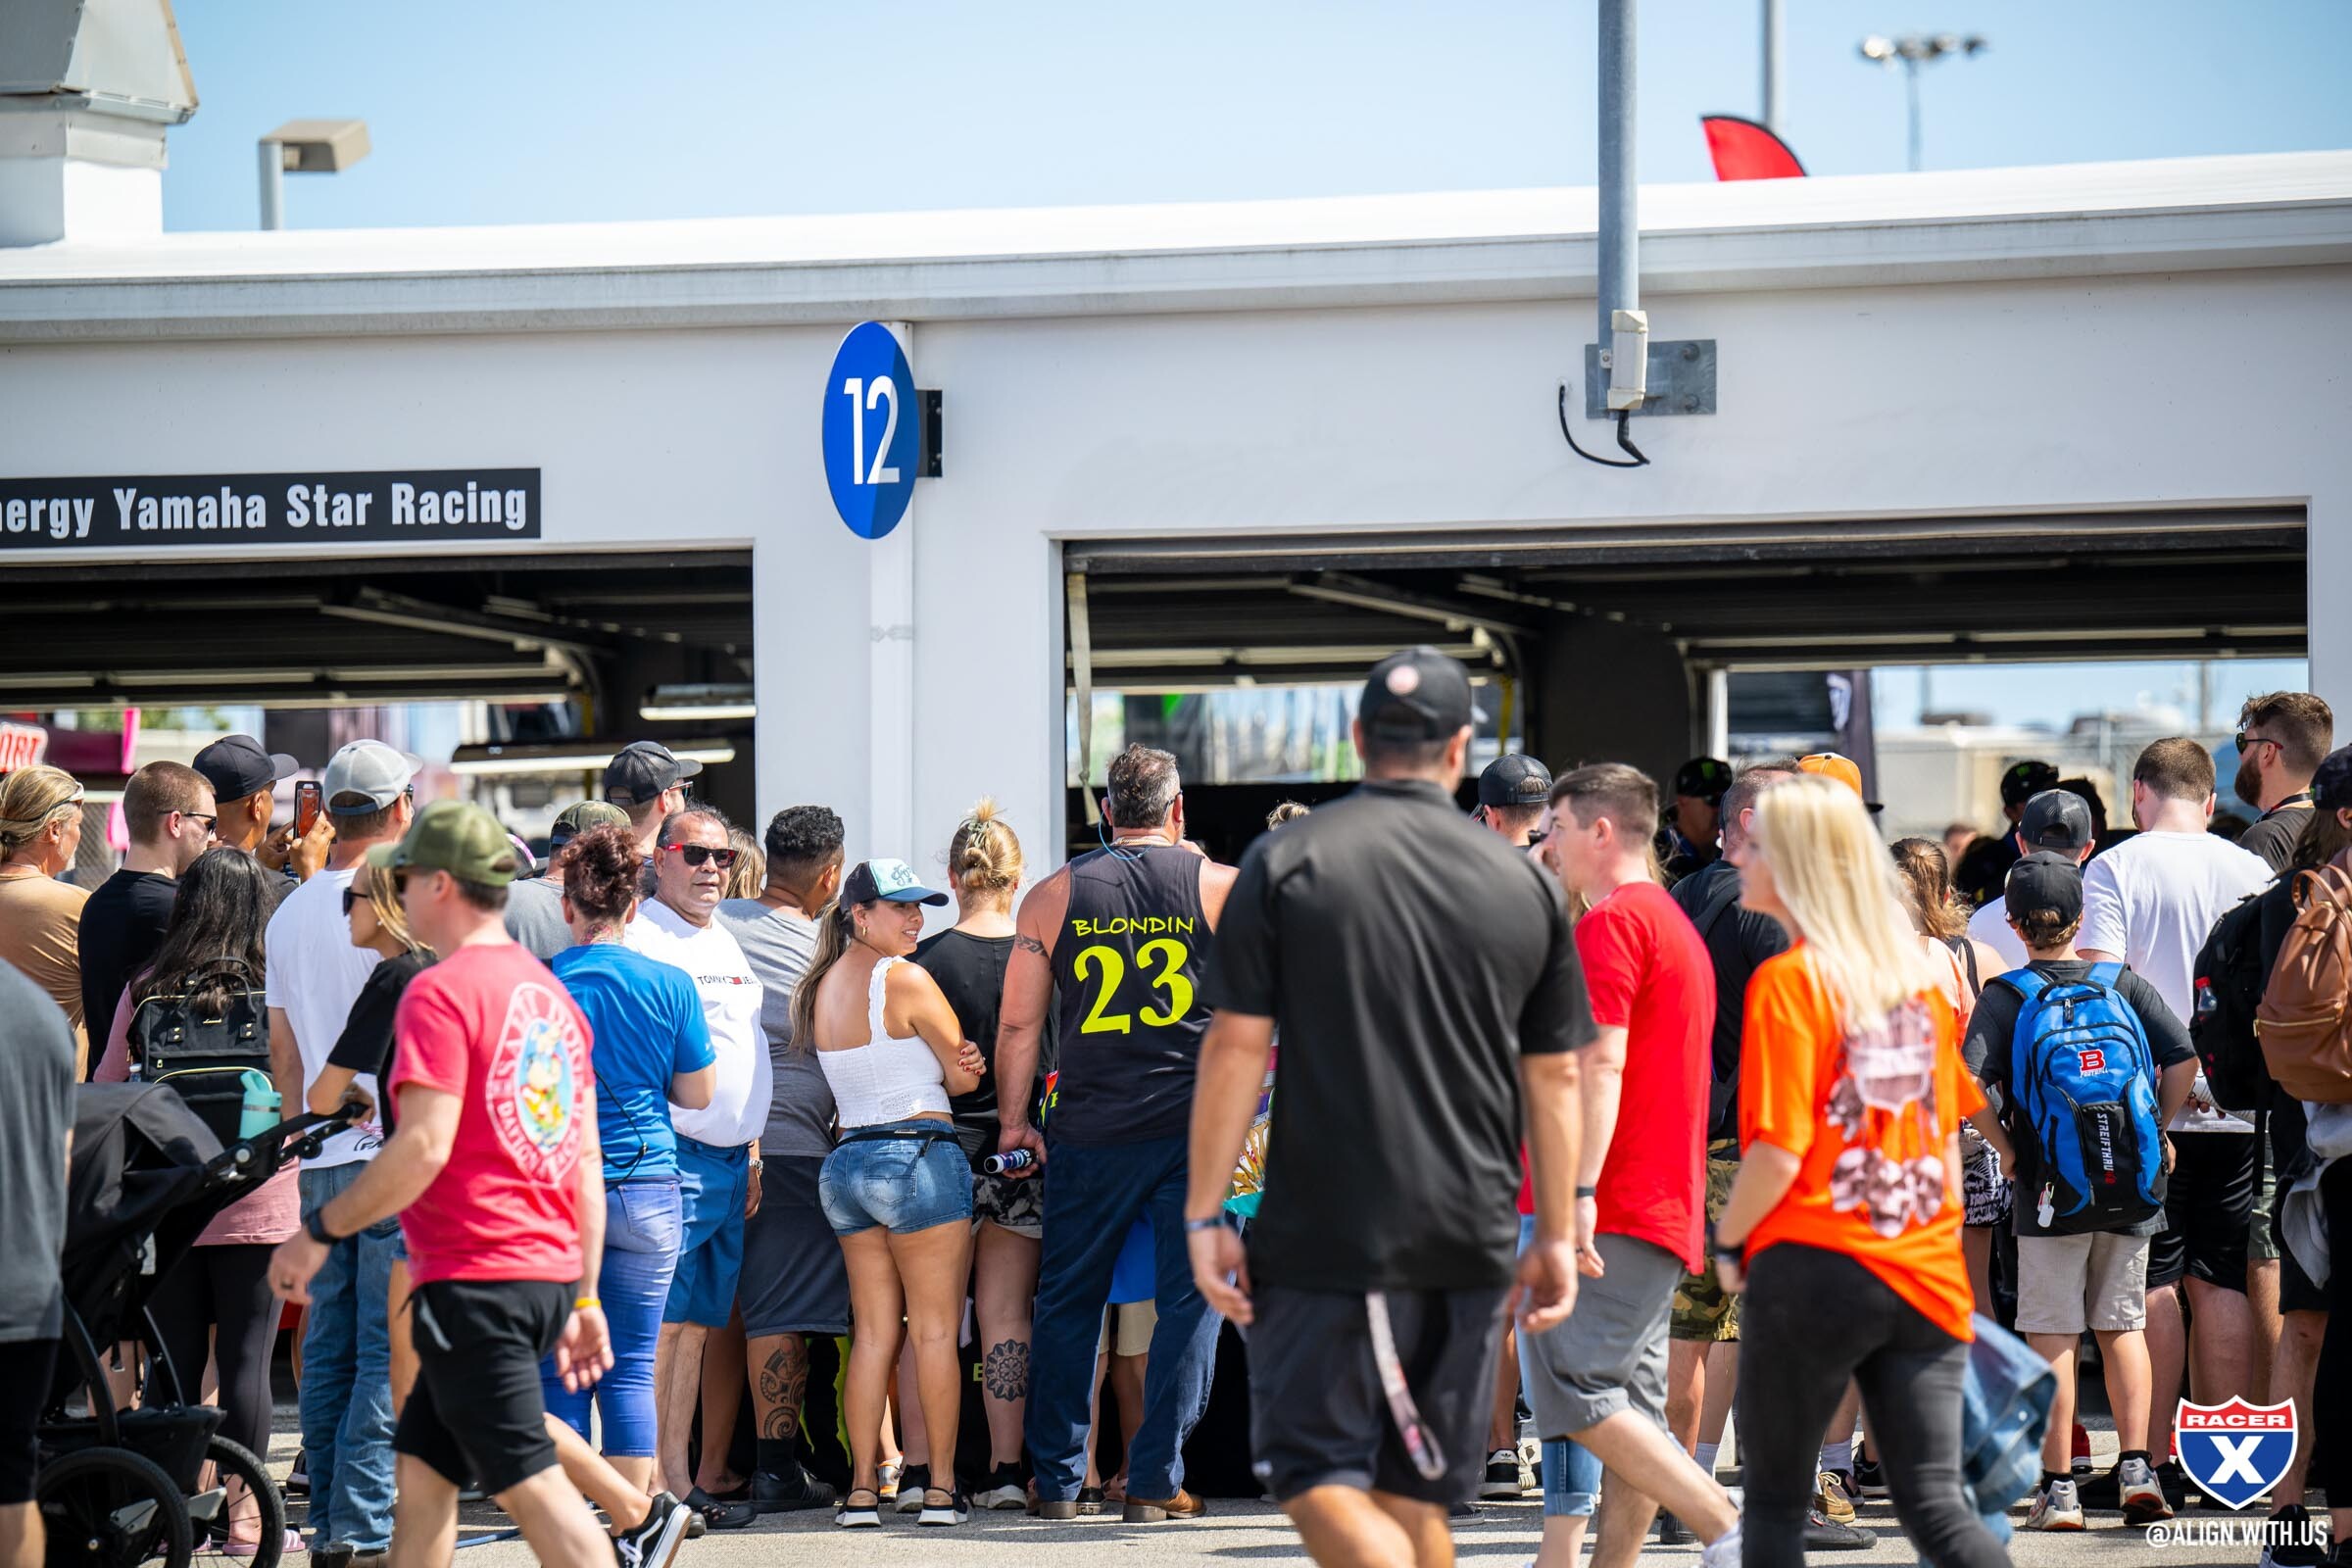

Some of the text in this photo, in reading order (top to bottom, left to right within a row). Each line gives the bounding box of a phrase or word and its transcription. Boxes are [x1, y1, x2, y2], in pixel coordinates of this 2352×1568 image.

[843, 375, 901, 485] 12
[0, 480, 526, 540] ergy Yamaha Star Racing
[1071, 916, 1194, 937] BLONDIN
[1073, 938, 1194, 1035] 23
[2078, 1049, 2106, 1072] B
